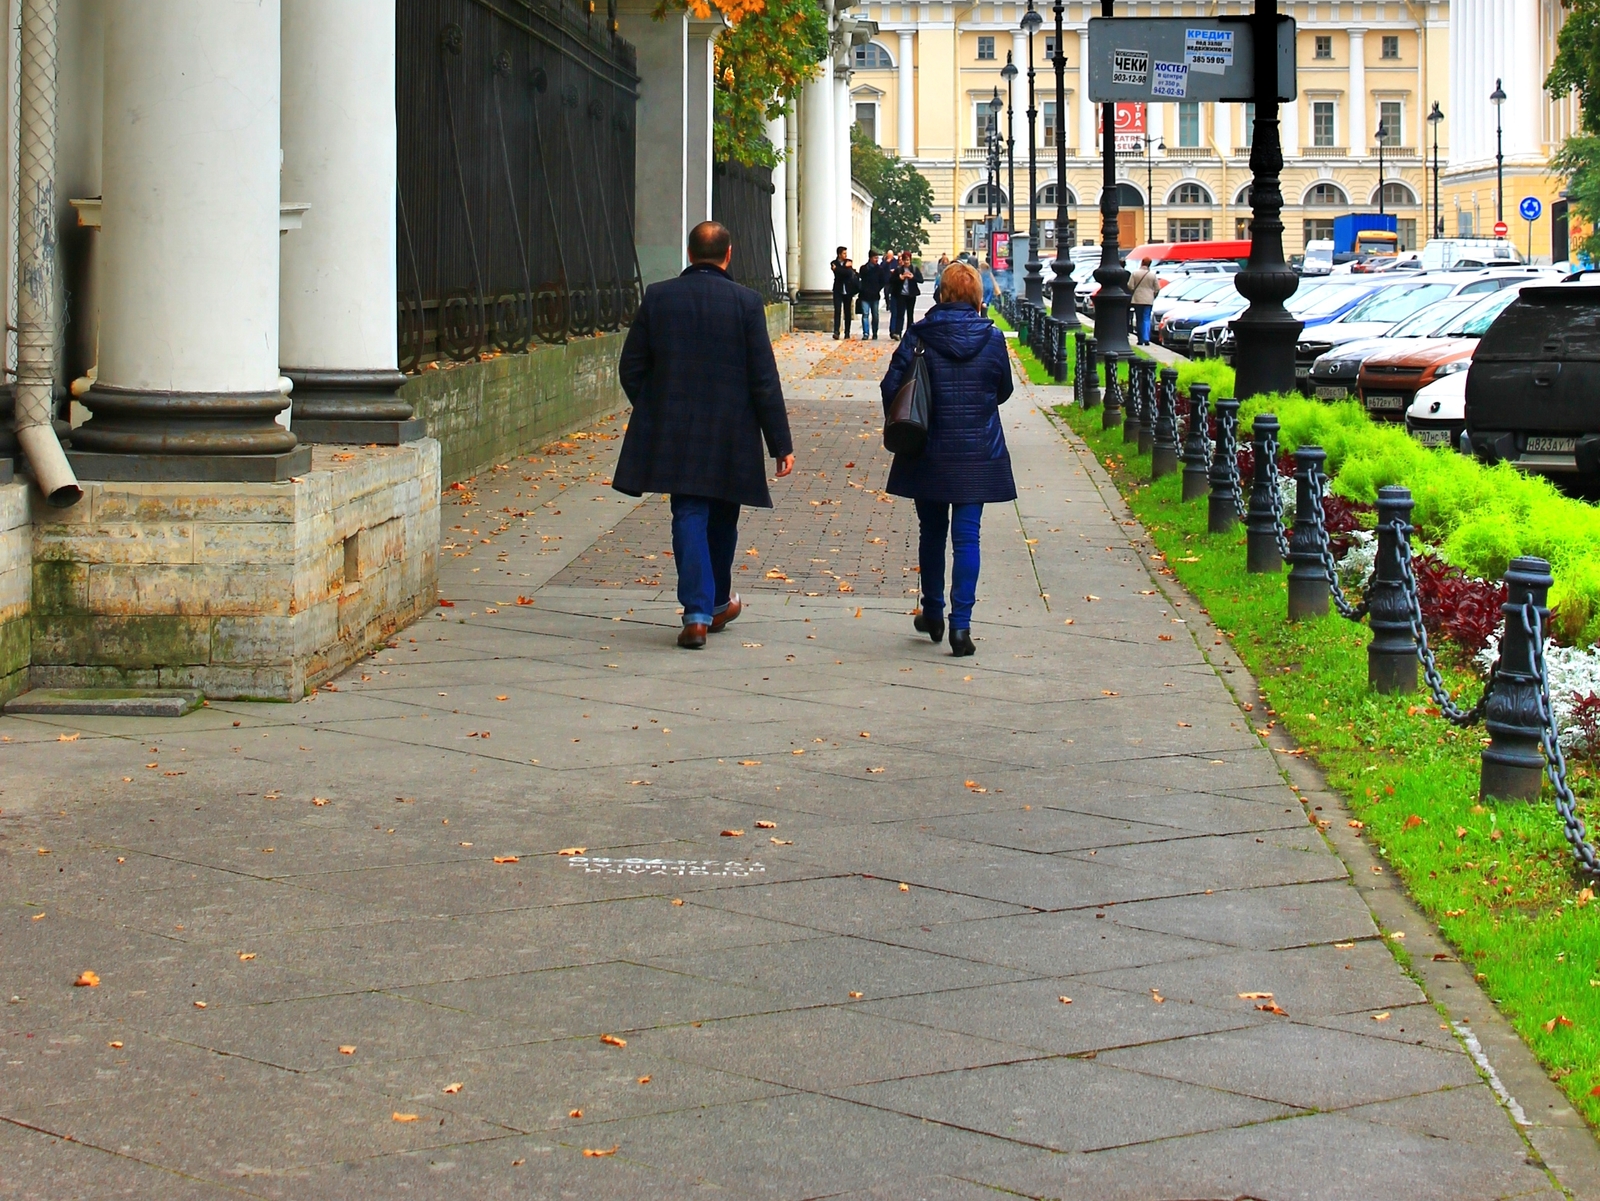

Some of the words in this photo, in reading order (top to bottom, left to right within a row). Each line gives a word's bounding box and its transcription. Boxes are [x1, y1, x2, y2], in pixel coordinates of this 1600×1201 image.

[1188, 30, 1232, 40] КРЕДИТ
[1115, 57, 1147, 72] ЧЕКИ
[1206, 56, 1215, 64] 59
[1154, 63, 1187, 73] ХОСТЕЛ
[1114, 73, 1146, 83] 903-12-98
[1134, 102, 1142, 126] ТРА
